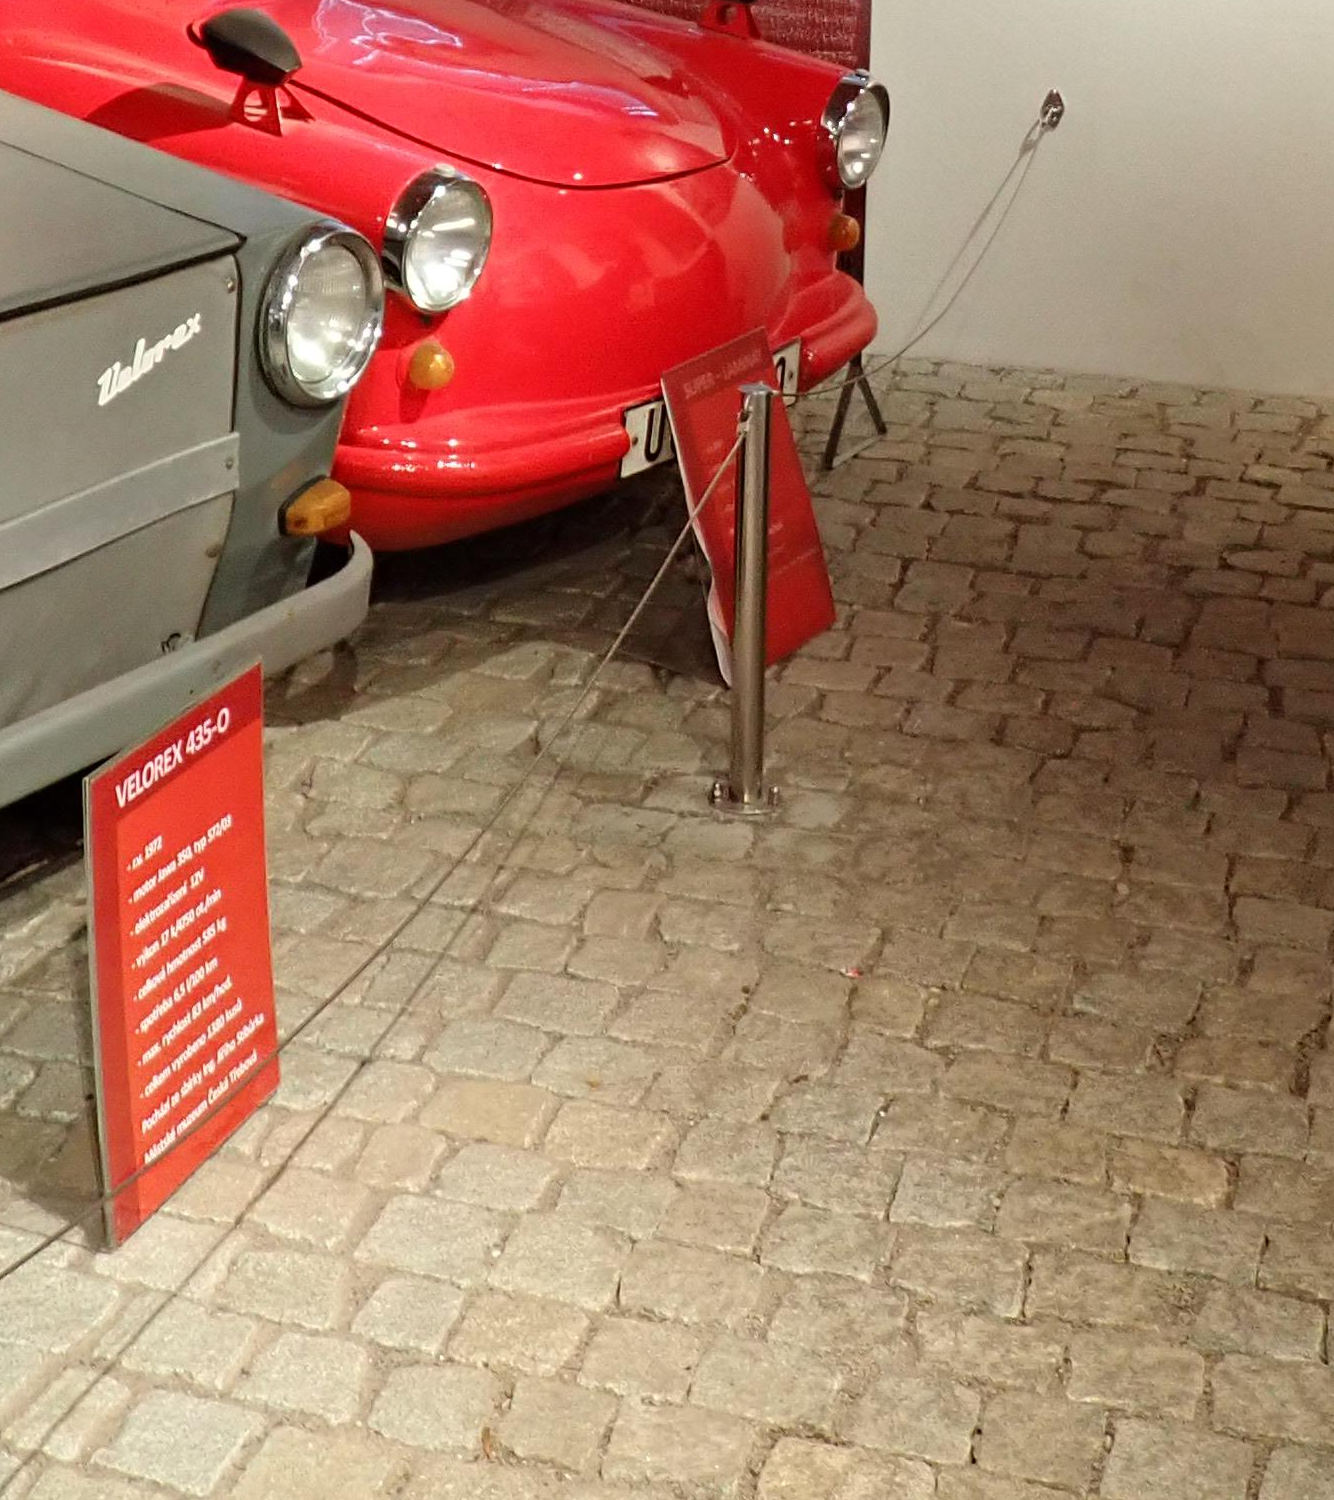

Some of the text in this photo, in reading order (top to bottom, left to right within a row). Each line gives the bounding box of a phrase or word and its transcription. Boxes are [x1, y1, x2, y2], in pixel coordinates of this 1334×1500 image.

[97, 313, 201, 406] Velorex
[116, 708, 229, 807] VELOREX 435-O
[133, 875, 157, 903] motor
[166, 937, 203, 976] hmotnost
[216, 917, 227, 932] kg
[204, 957, 218, 975] km
[162, 1011, 192, 1048] rychlost
[144, 1066, 172, 1098] celkem
[171, 1033, 208, 1072] vyrobeno
[177, 1100, 208, 1134] muzeum
